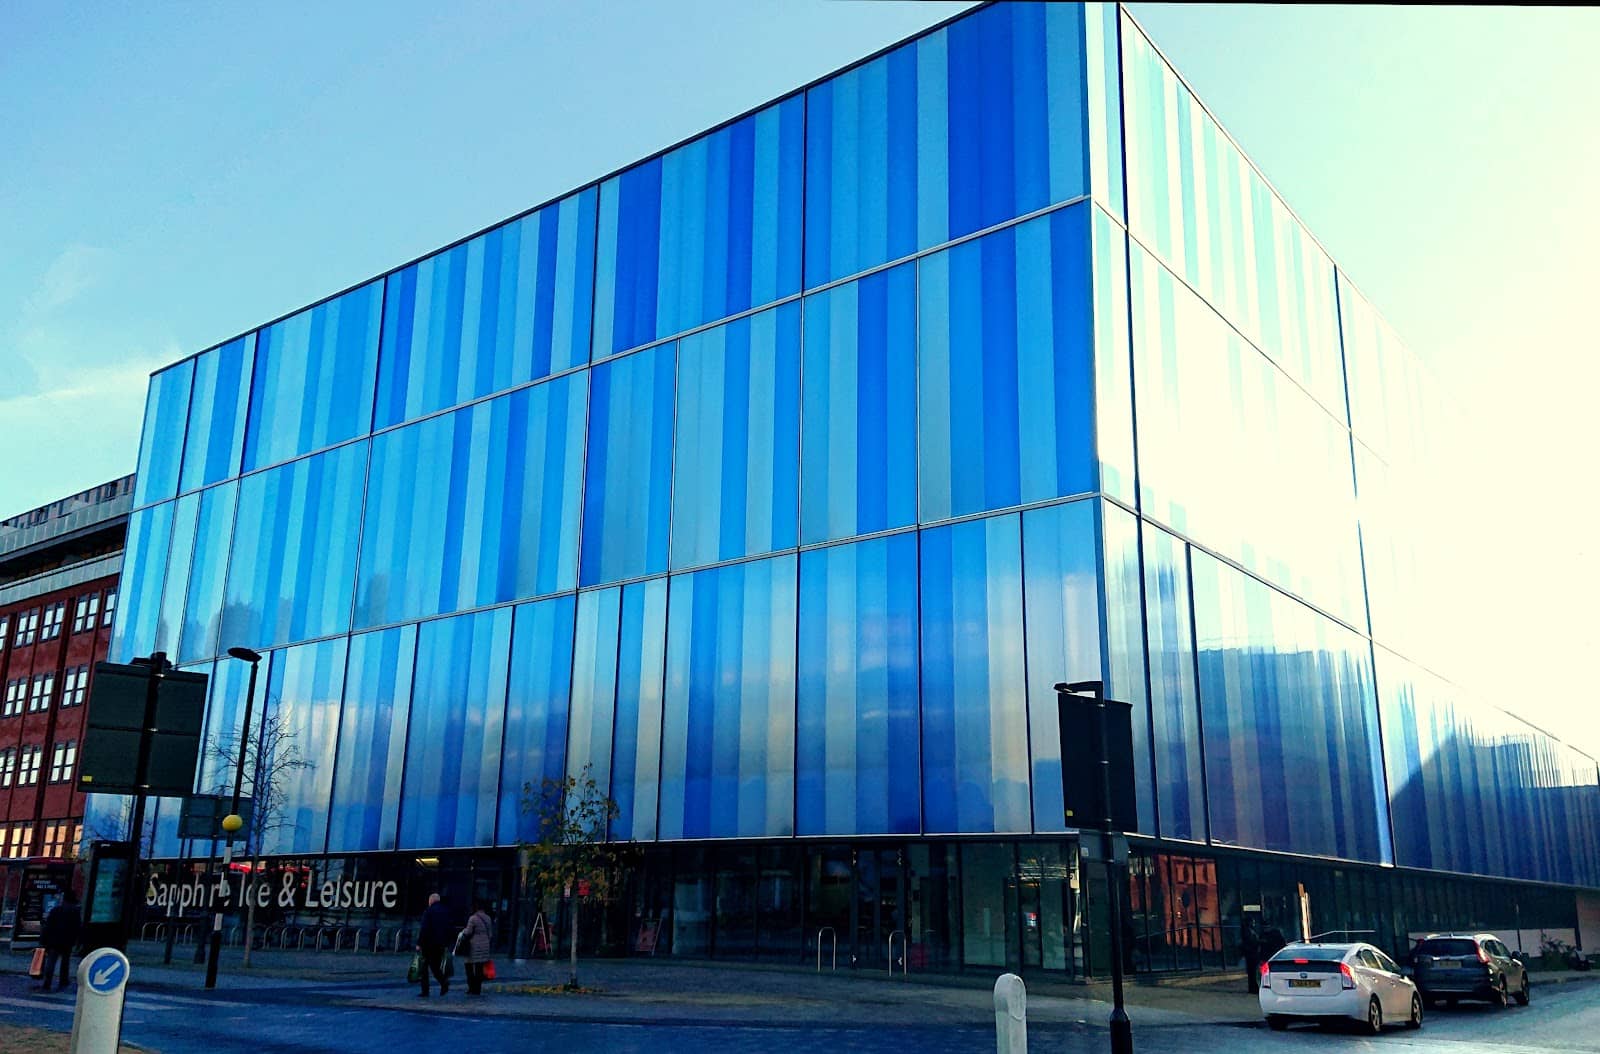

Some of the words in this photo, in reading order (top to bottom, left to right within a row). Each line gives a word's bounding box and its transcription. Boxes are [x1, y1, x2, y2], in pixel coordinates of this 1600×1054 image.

[238, 873, 271, 908] Ice
[278, 871, 296, 908] &
[305, 869, 398, 909] Leisure
